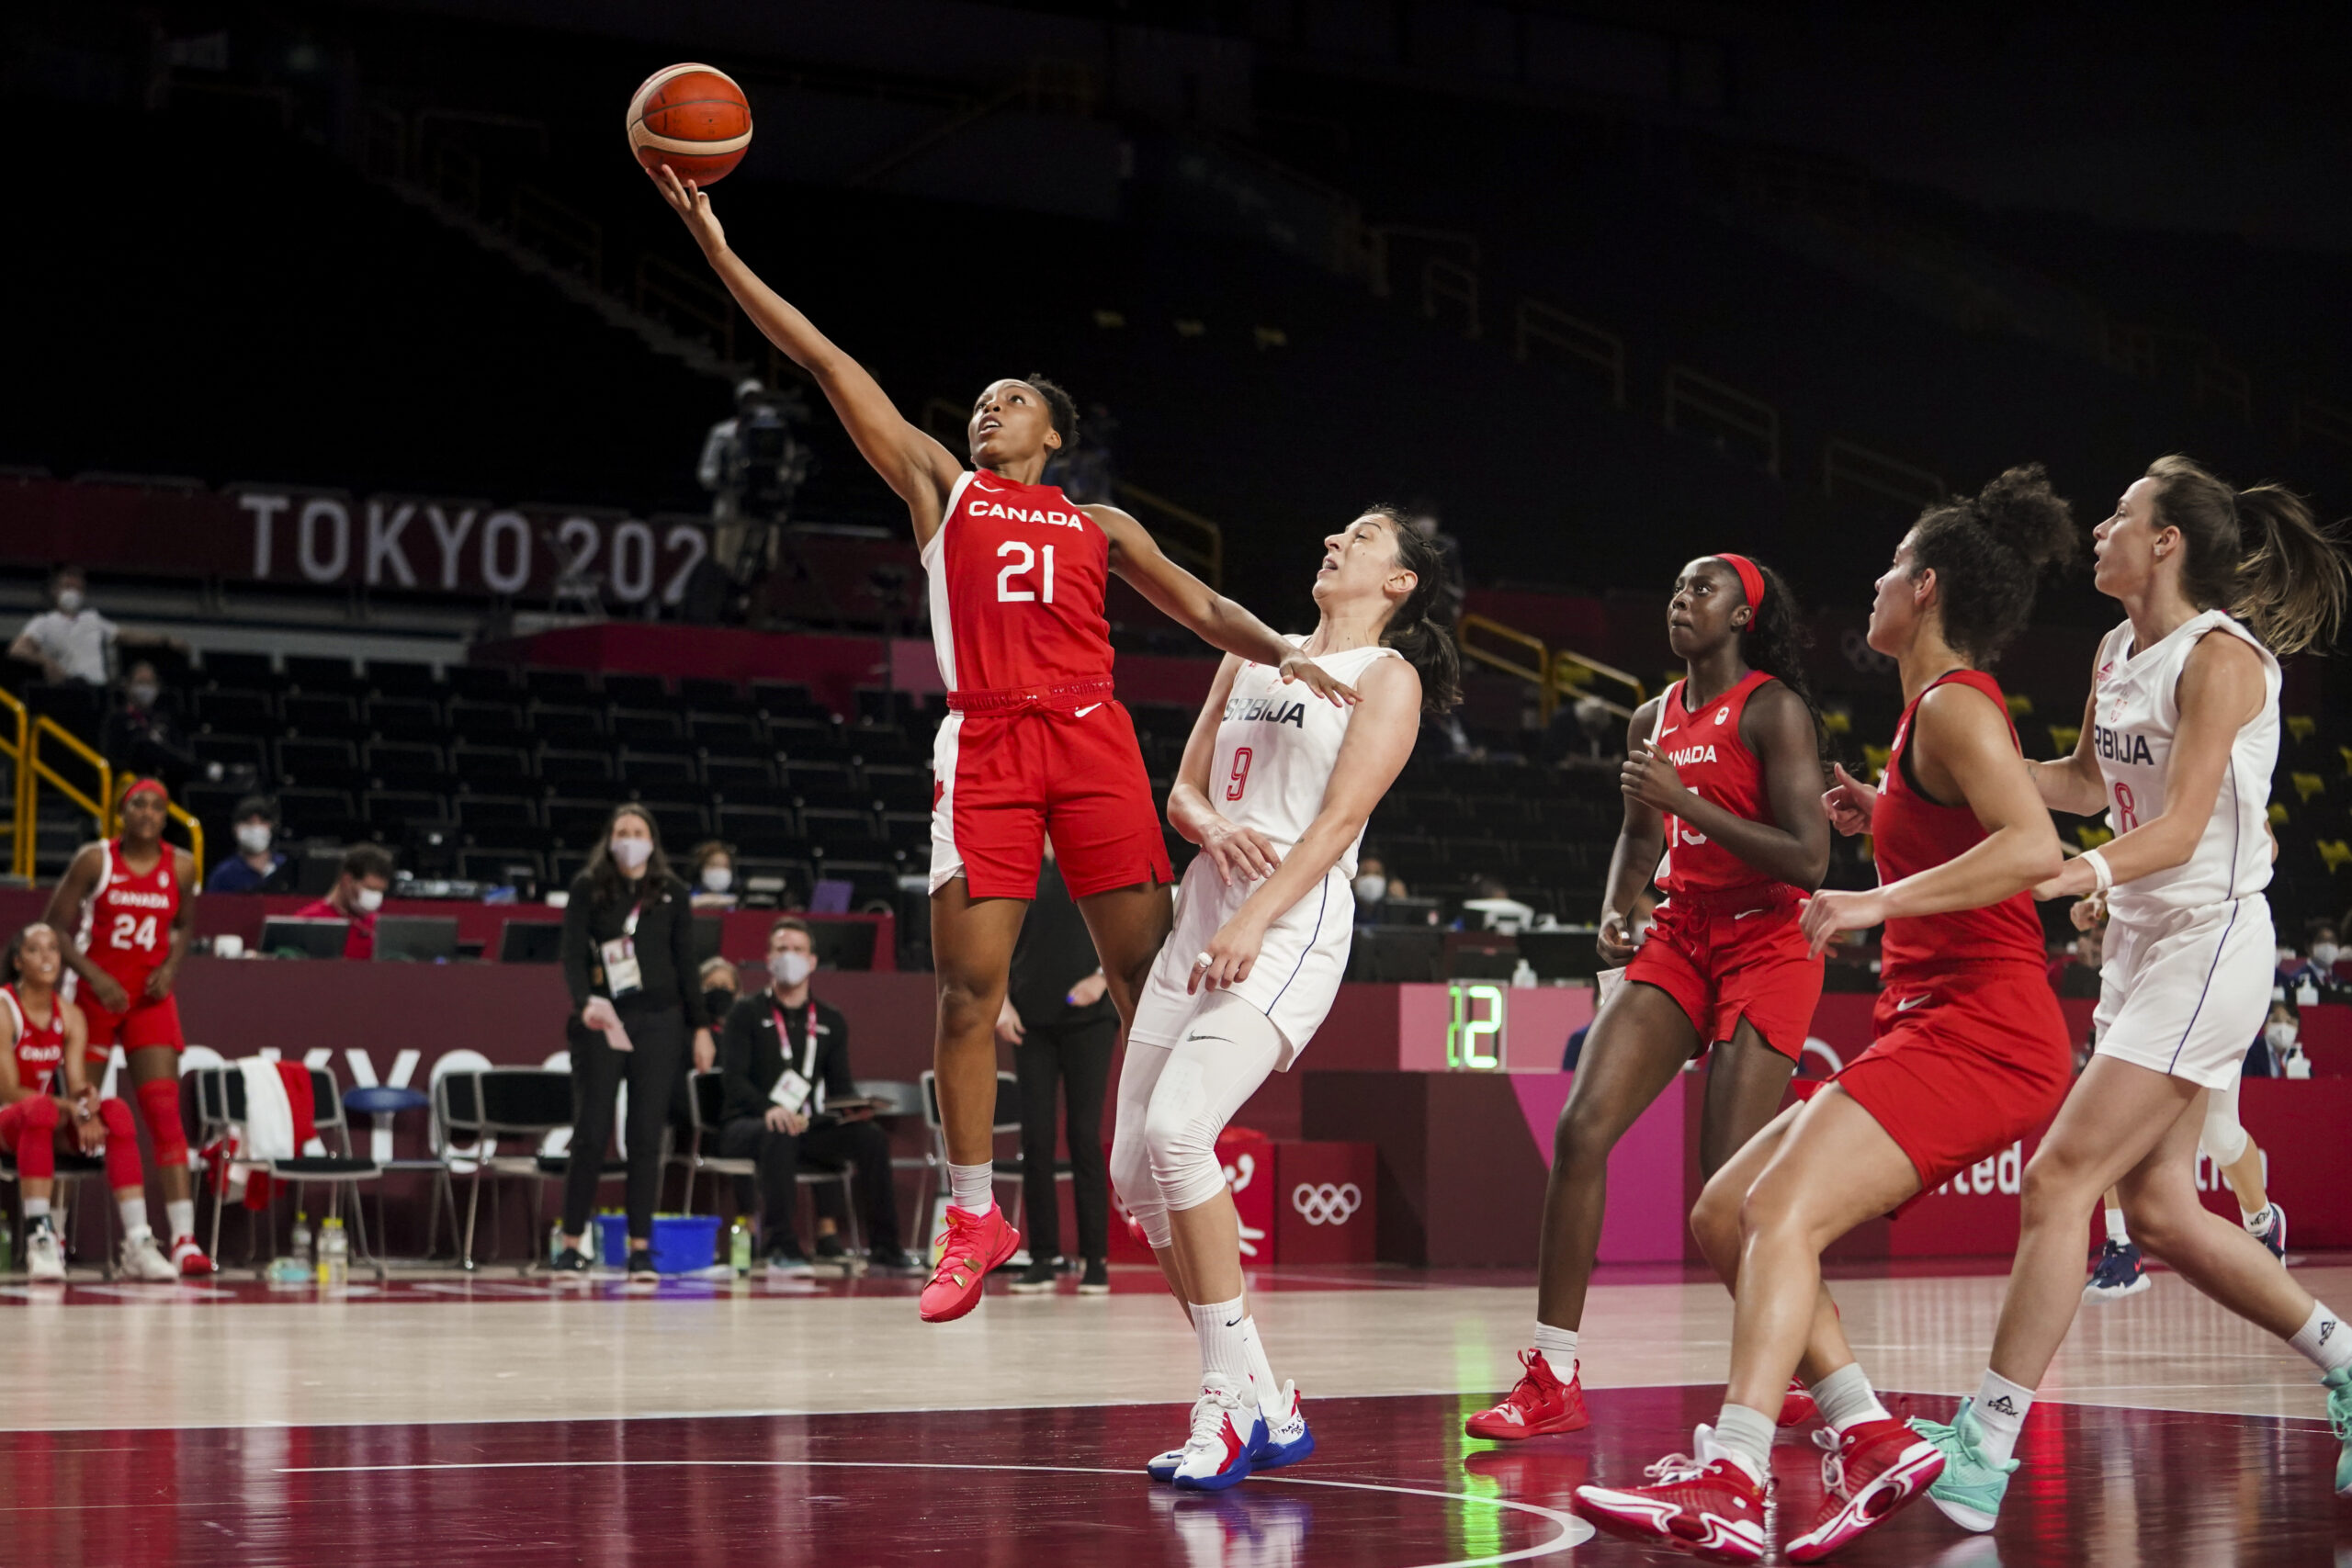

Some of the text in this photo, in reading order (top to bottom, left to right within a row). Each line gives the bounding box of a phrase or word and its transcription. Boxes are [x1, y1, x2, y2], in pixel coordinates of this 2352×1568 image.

[968, 501, 1084, 532] CANADA
[238, 494, 533, 595] TOKYO
[997, 540, 1055, 604] 21
[1222, 698, 1306, 728] SRBIJA
[1668, 745, 1718, 767] NADA
[2095, 724, 2154, 765] RBIJA
[1227, 747, 1252, 801] 9
[2114, 782, 2139, 834] 8
[107, 889, 170, 909] CANADA
[109, 913, 158, 953] 24
[18, 1043, 62, 1061] CANAD
[36, 1069, 53, 1095] 7
